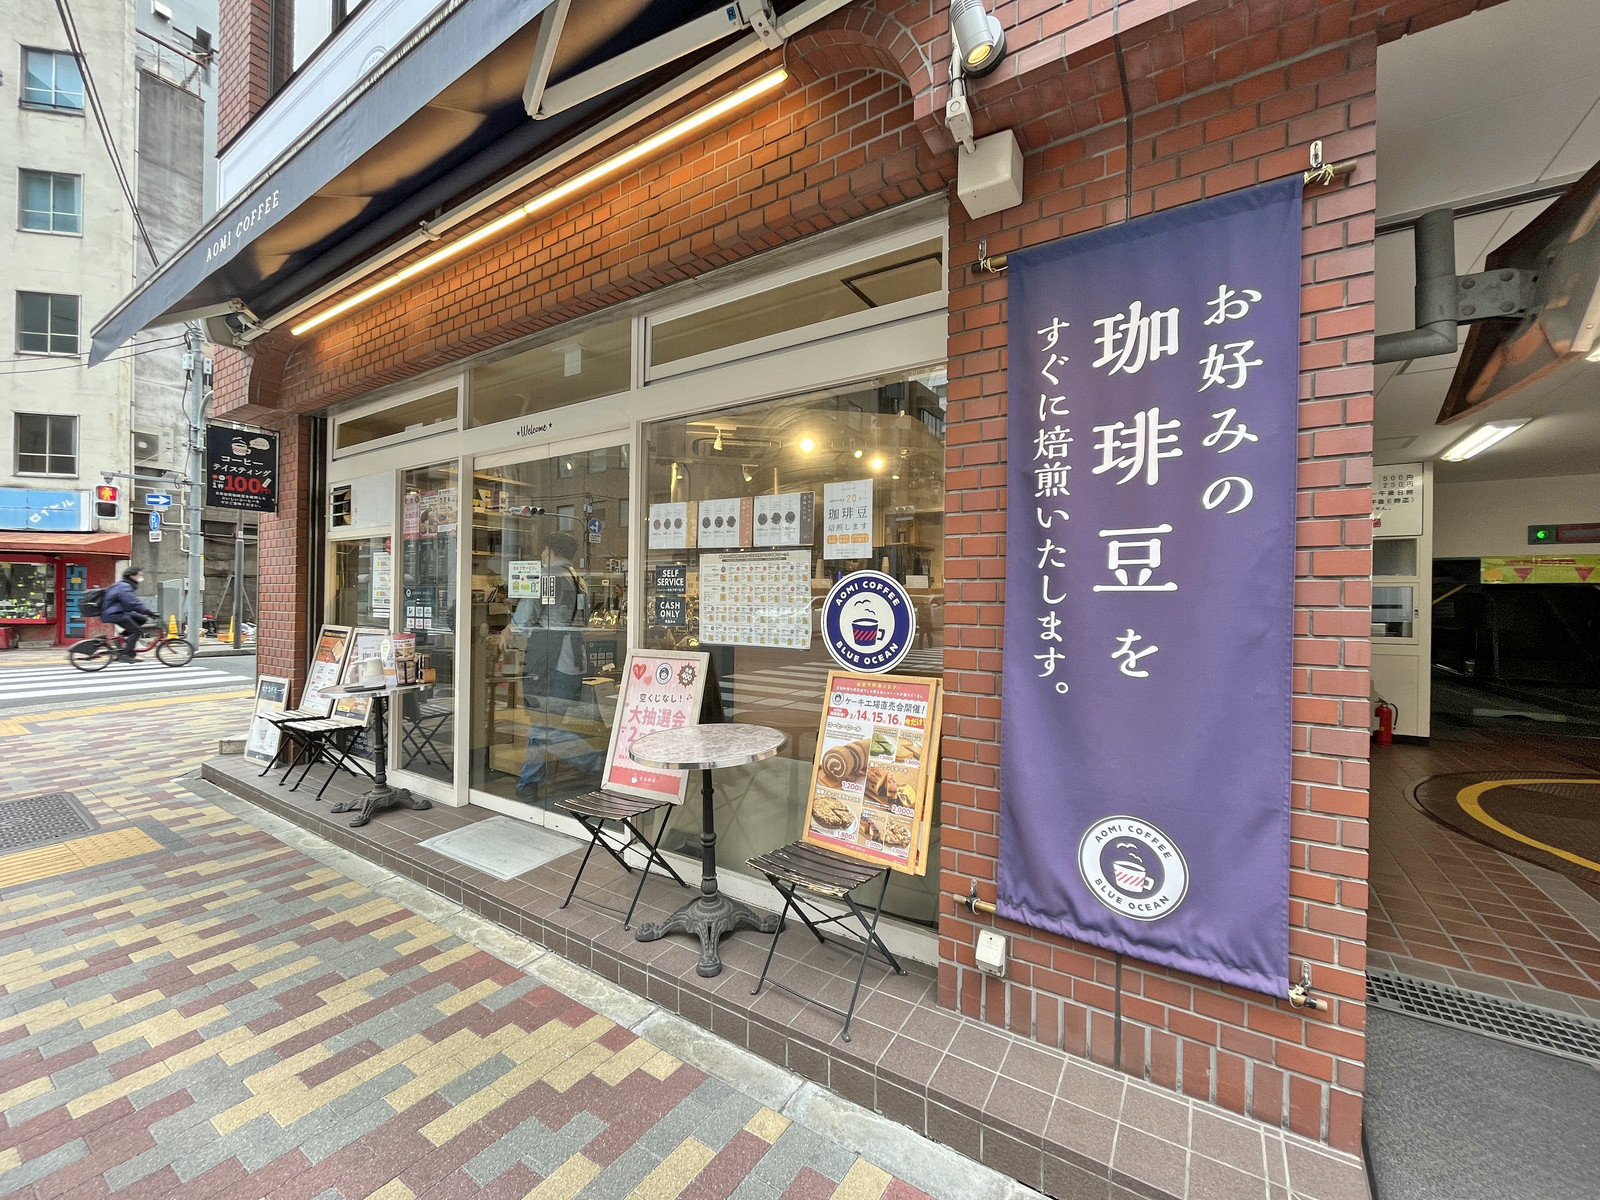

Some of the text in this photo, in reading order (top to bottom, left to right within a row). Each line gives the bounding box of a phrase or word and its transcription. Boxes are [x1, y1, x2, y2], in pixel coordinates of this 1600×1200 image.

[206, 189, 280, 263] AOMI COFFEE
[1198, 284, 1263, 514] お好みの
[520, 424, 548, 437] Welcome
[212, 463, 272, 477] テイスティング
[221, 455, 264, 466] コーヒー
[1092, 300, 1184, 678] 珈琲豆を
[828, 505, 868, 521] 珈琲豆
[1033, 317, 1074, 694] すぐに焙煎いたします。
[657, 578, 684, 586] SERVICE
[662, 569, 679, 578] SELF
[836, 581, 901, 606] AOMI COFFEE
[660, 601, 681, 610] CASH
[660, 610, 680, 618] ONLY
[836, 640, 899, 665] BLUE OCEAN
[639, 693, 683, 703] 空くじなし！
[845, 696, 925, 715] ケーキ工場直売会開催！
[628, 705, 687, 728] 大抽選会
[1095, 824, 1172, 859] AOMI COFFEE
[1095, 878, 1170, 911] BLUE OCEAN
